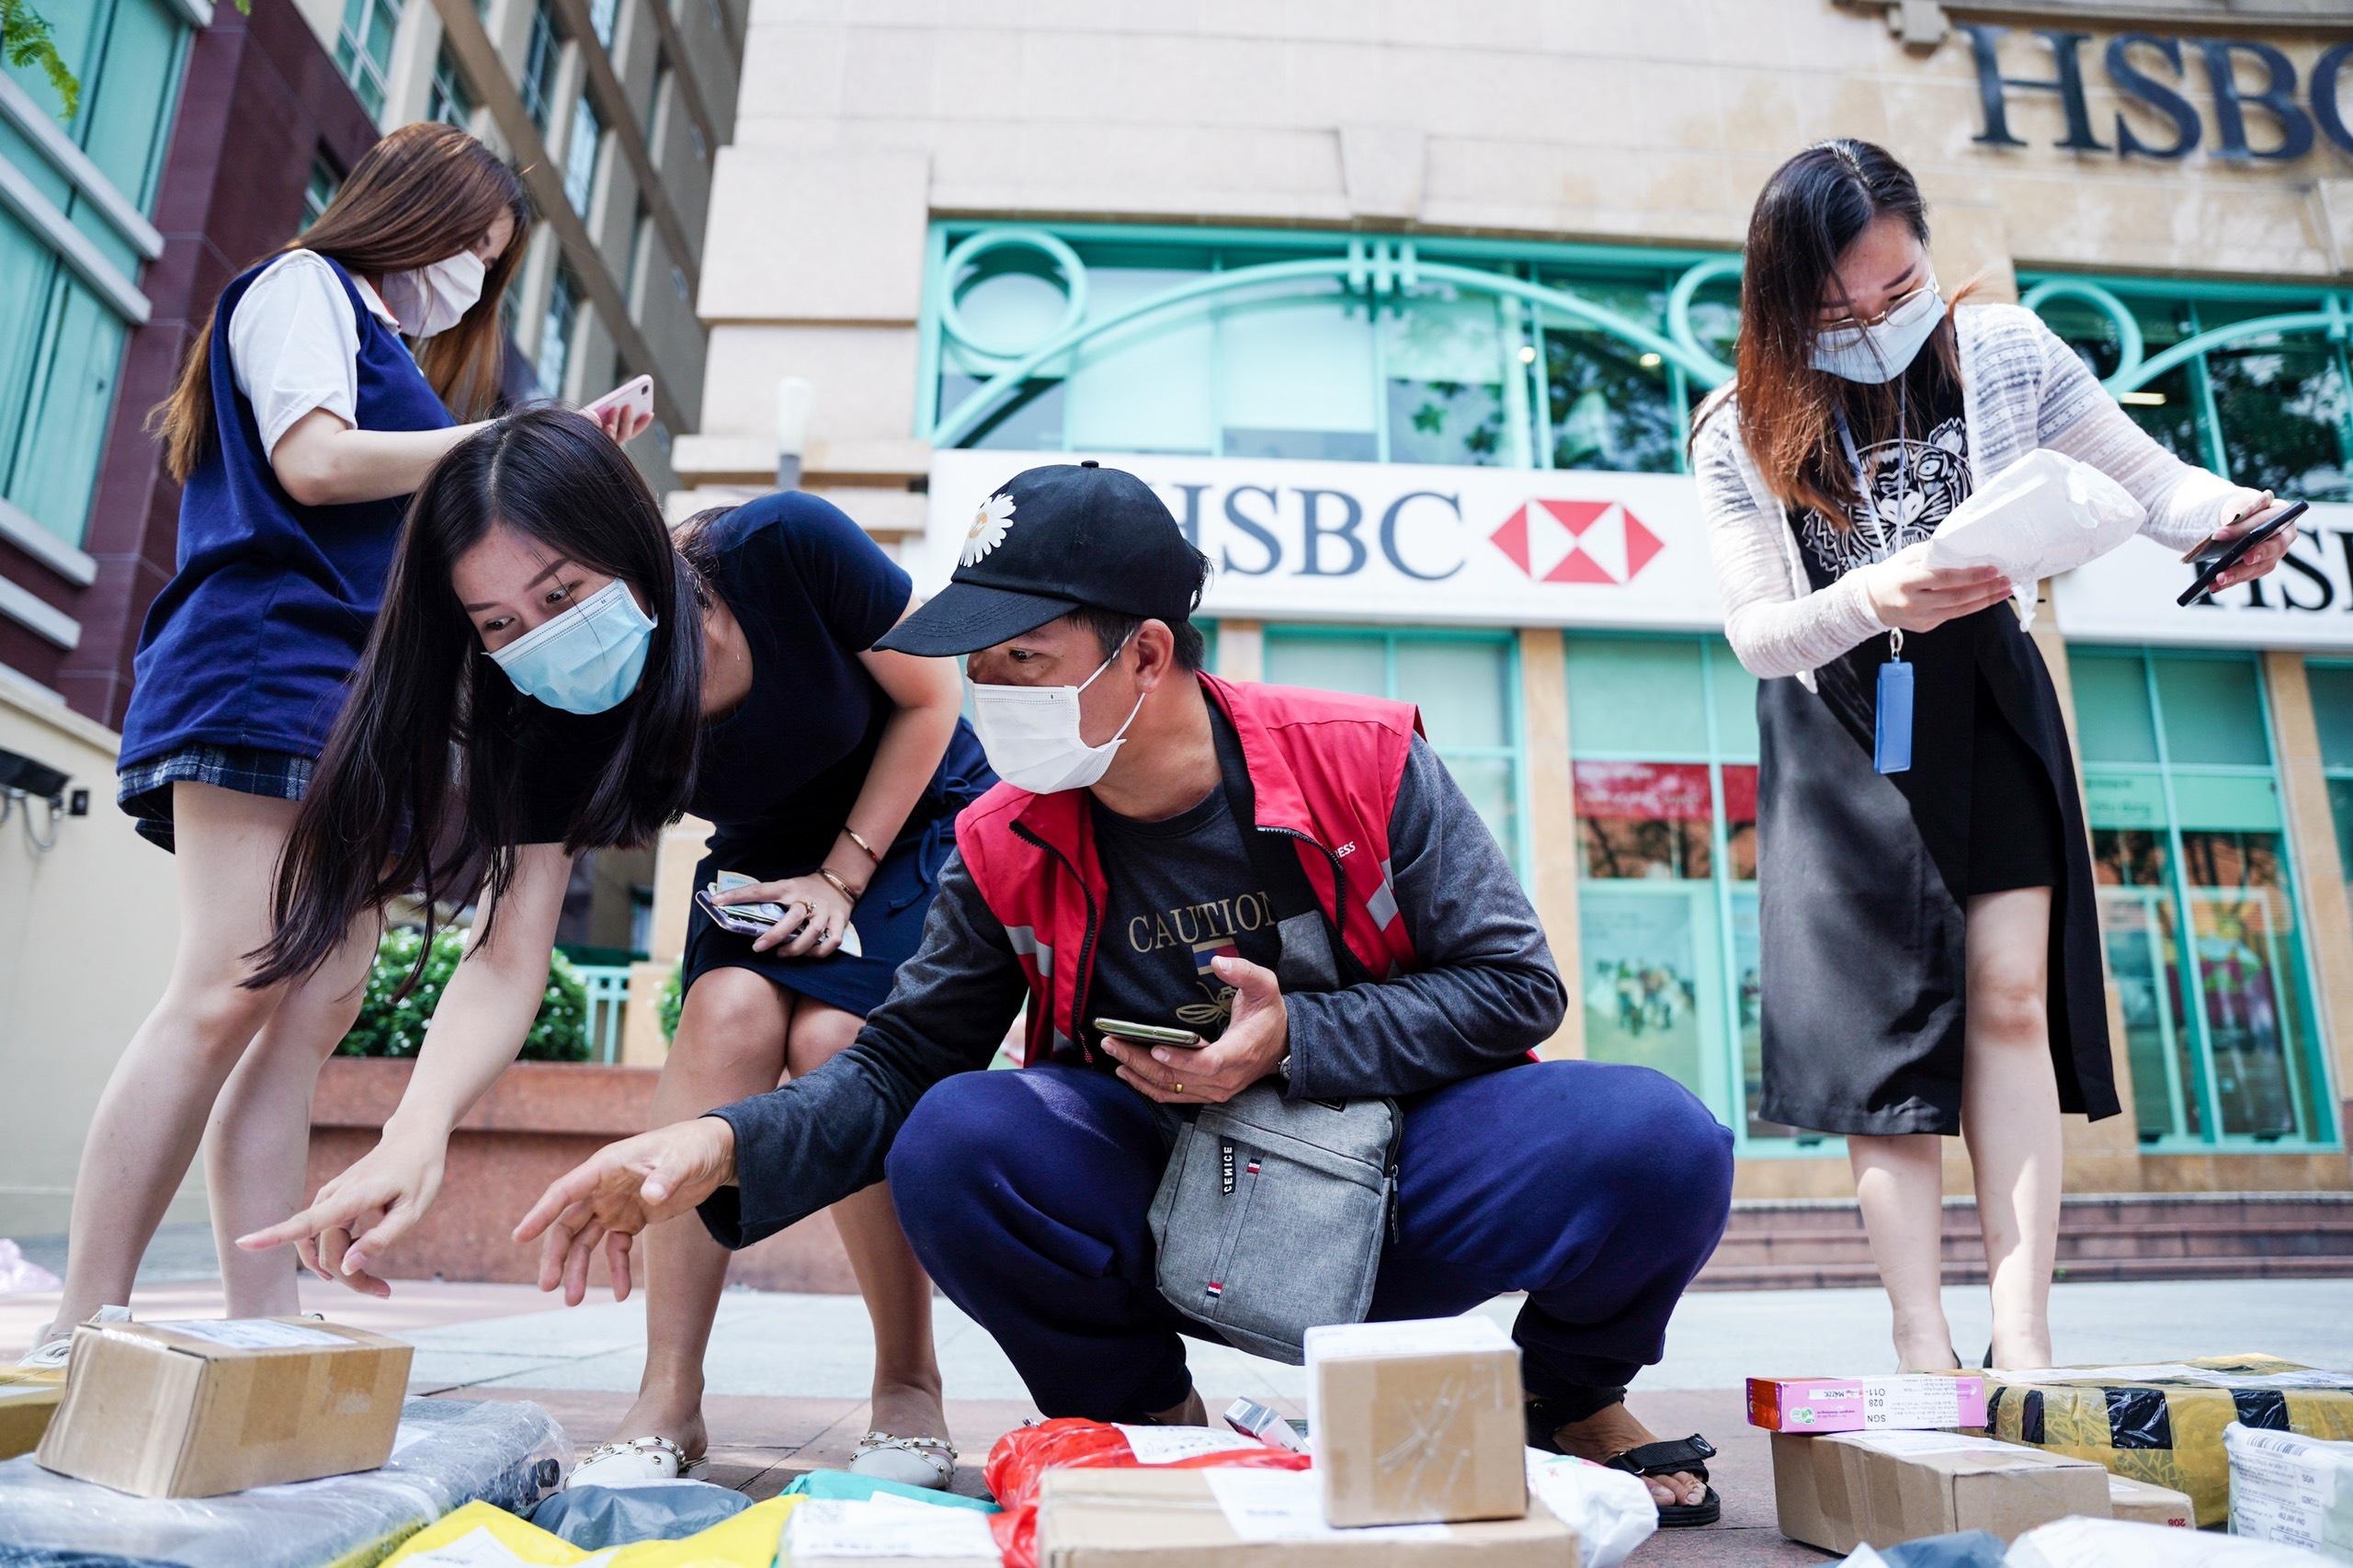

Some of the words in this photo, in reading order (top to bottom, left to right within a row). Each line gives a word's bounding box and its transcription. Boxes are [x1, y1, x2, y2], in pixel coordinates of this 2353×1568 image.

[1869, 1399, 1884, 1407] 028
[1867, 1414, 1886, 1423] SGN
[2167, 1518, 2187, 1527] 208
